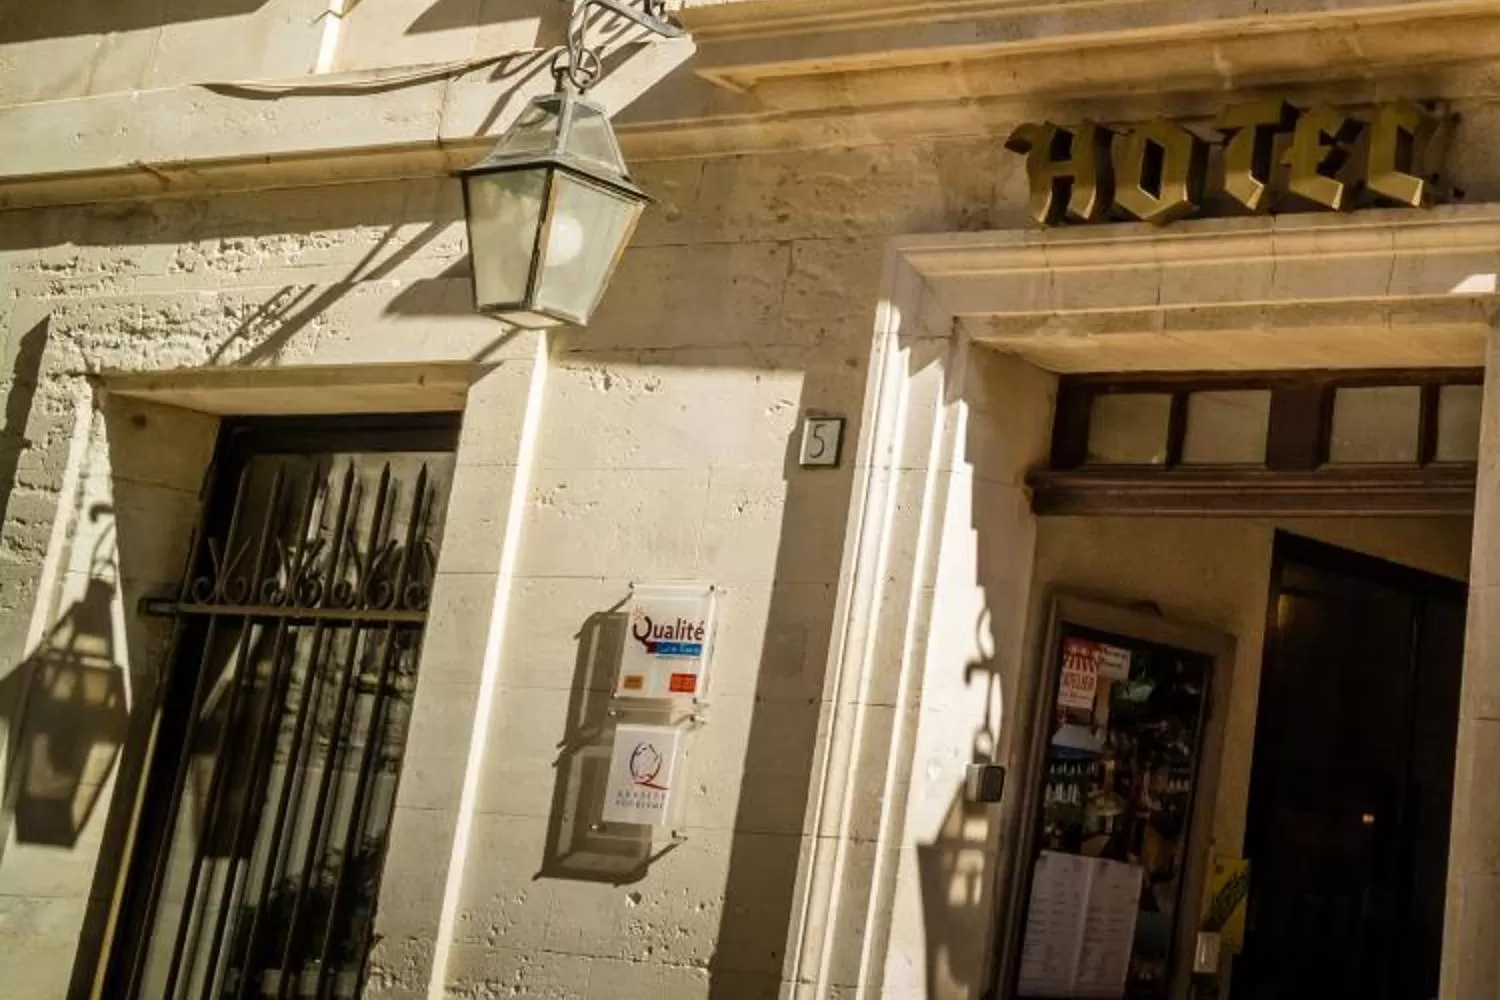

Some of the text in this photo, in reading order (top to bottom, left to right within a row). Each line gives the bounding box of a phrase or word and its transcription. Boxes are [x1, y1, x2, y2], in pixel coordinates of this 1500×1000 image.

[1004, 100, 1430, 225] HOTEL
[810, 424, 827, 460] 5
[633, 615, 705, 650] Qualité
